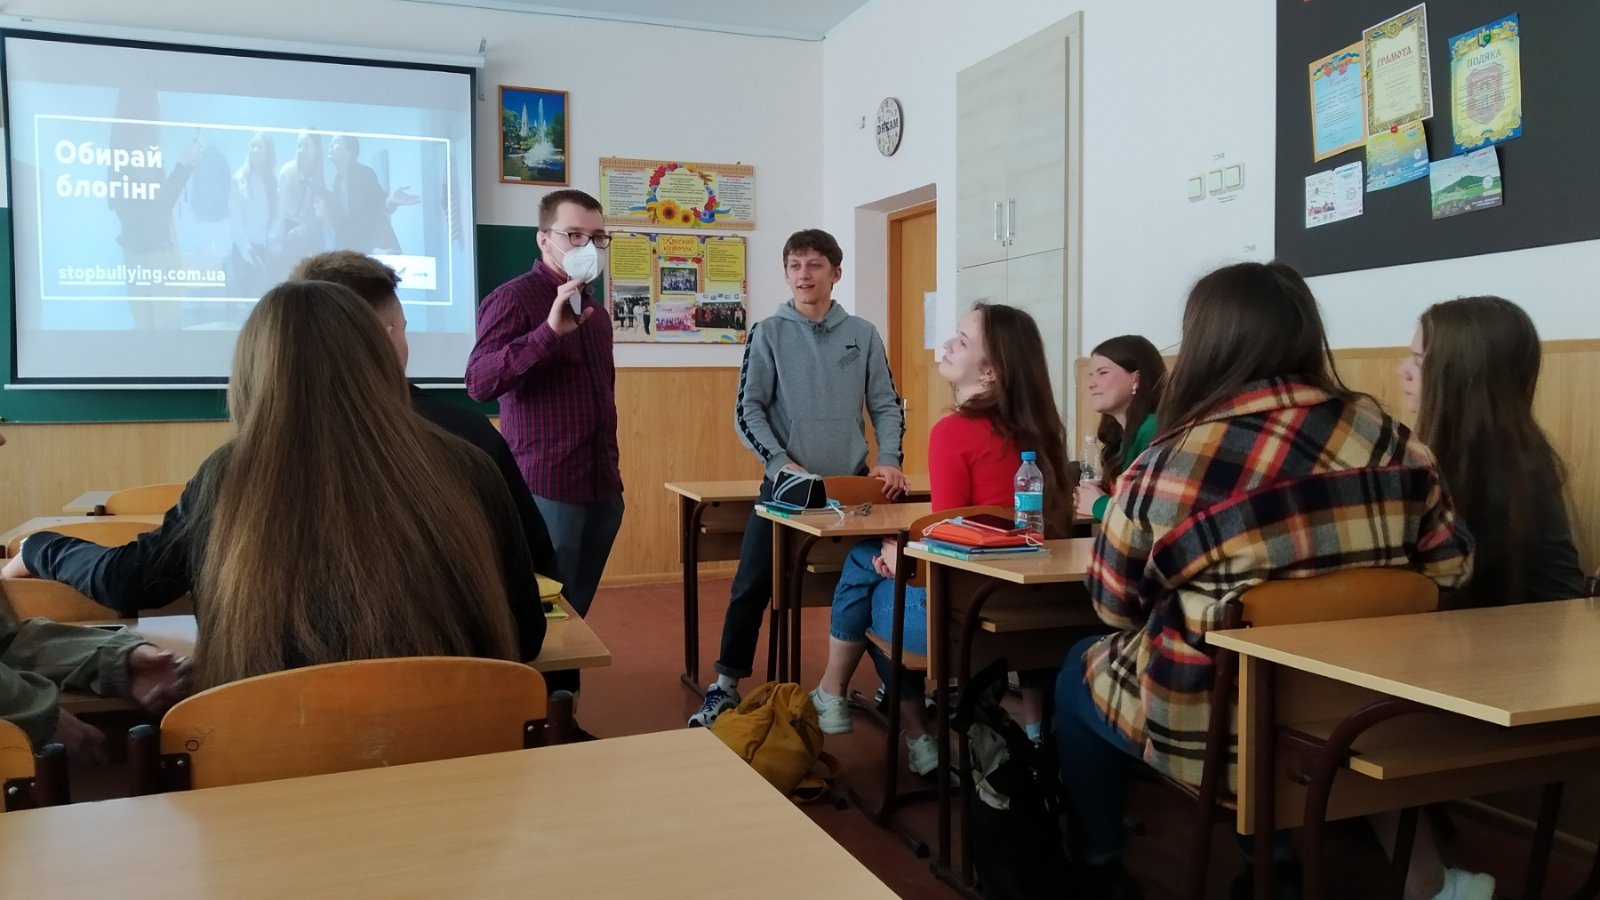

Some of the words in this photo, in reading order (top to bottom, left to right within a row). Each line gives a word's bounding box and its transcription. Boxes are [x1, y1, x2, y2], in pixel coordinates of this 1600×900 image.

[1377, 46, 1412, 67] ГРАМОТА
[54, 139, 163, 172] Обирай
[55, 173, 161, 201] блогінг
[57, 264, 226, 284] stopbullying.com.ua
